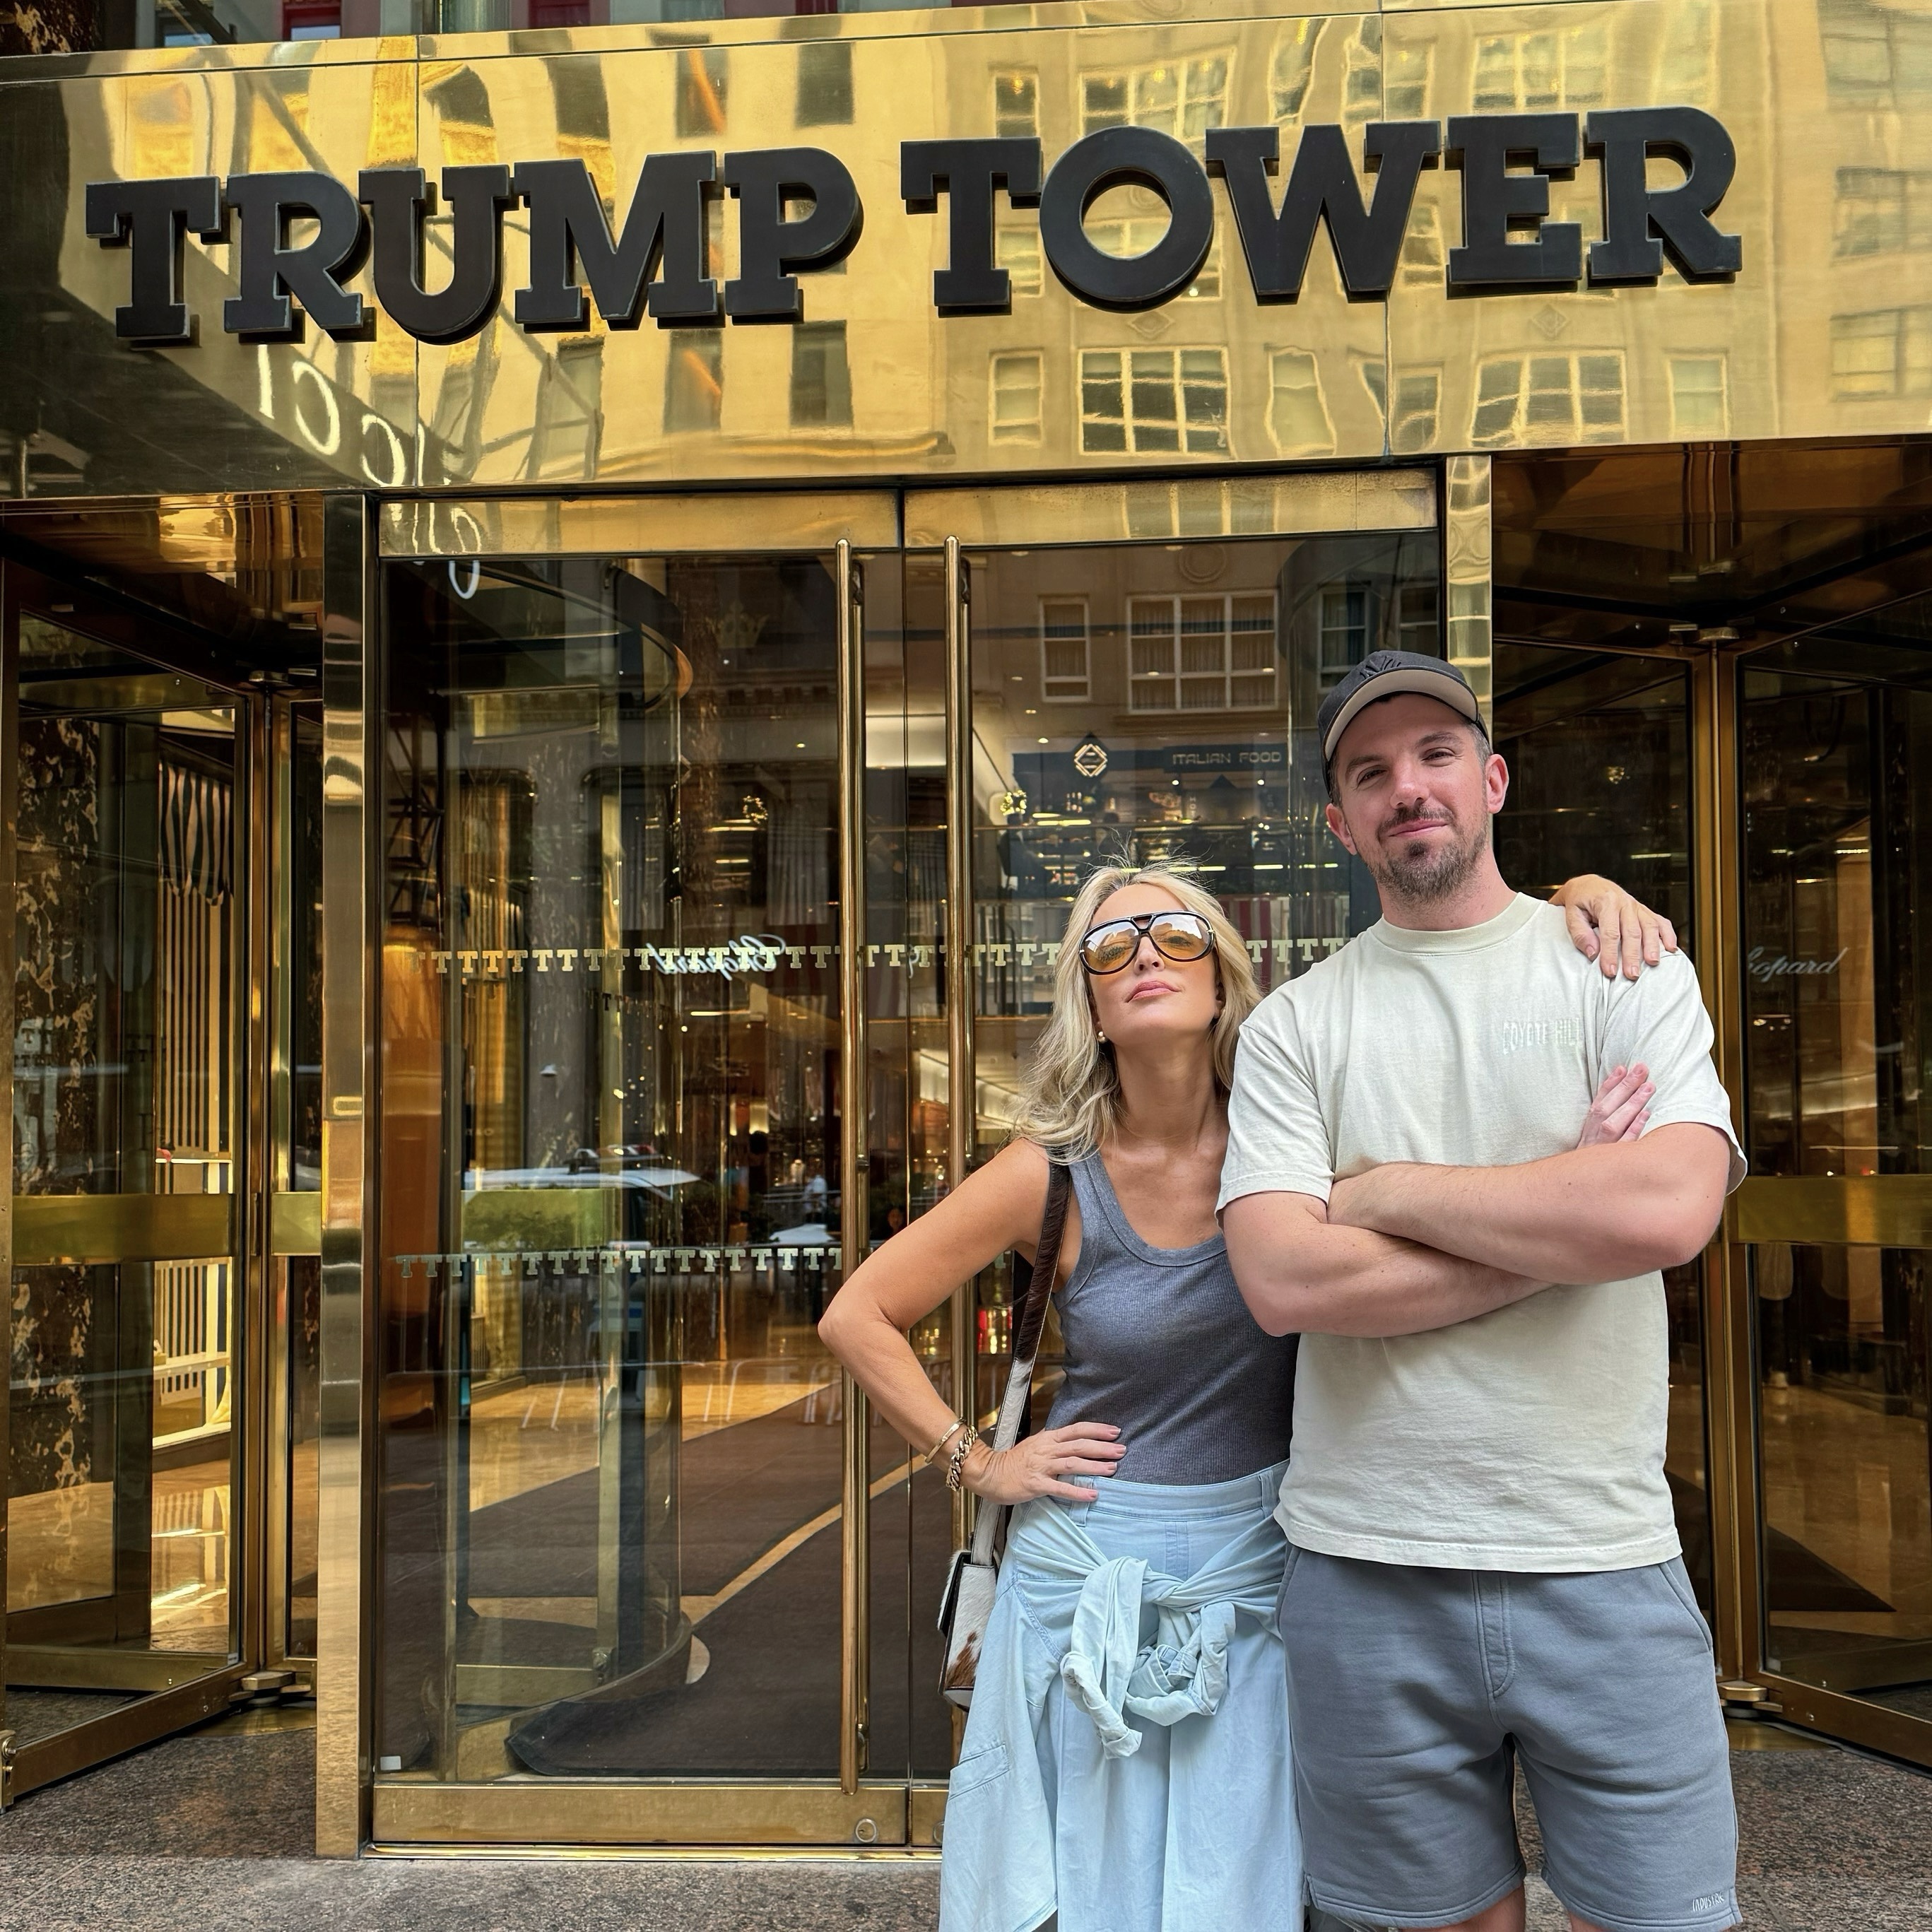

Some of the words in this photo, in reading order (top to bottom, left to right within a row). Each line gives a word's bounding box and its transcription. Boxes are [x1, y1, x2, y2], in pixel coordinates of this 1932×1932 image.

[86, 148, 862, 348] TRUMP
[900, 106, 1743, 317] TOWER
[1172, 753, 1231, 765] ITALIAN
[1239, 751, 1282, 763] FOOD
[1747, 946, 1849, 983] hopard
